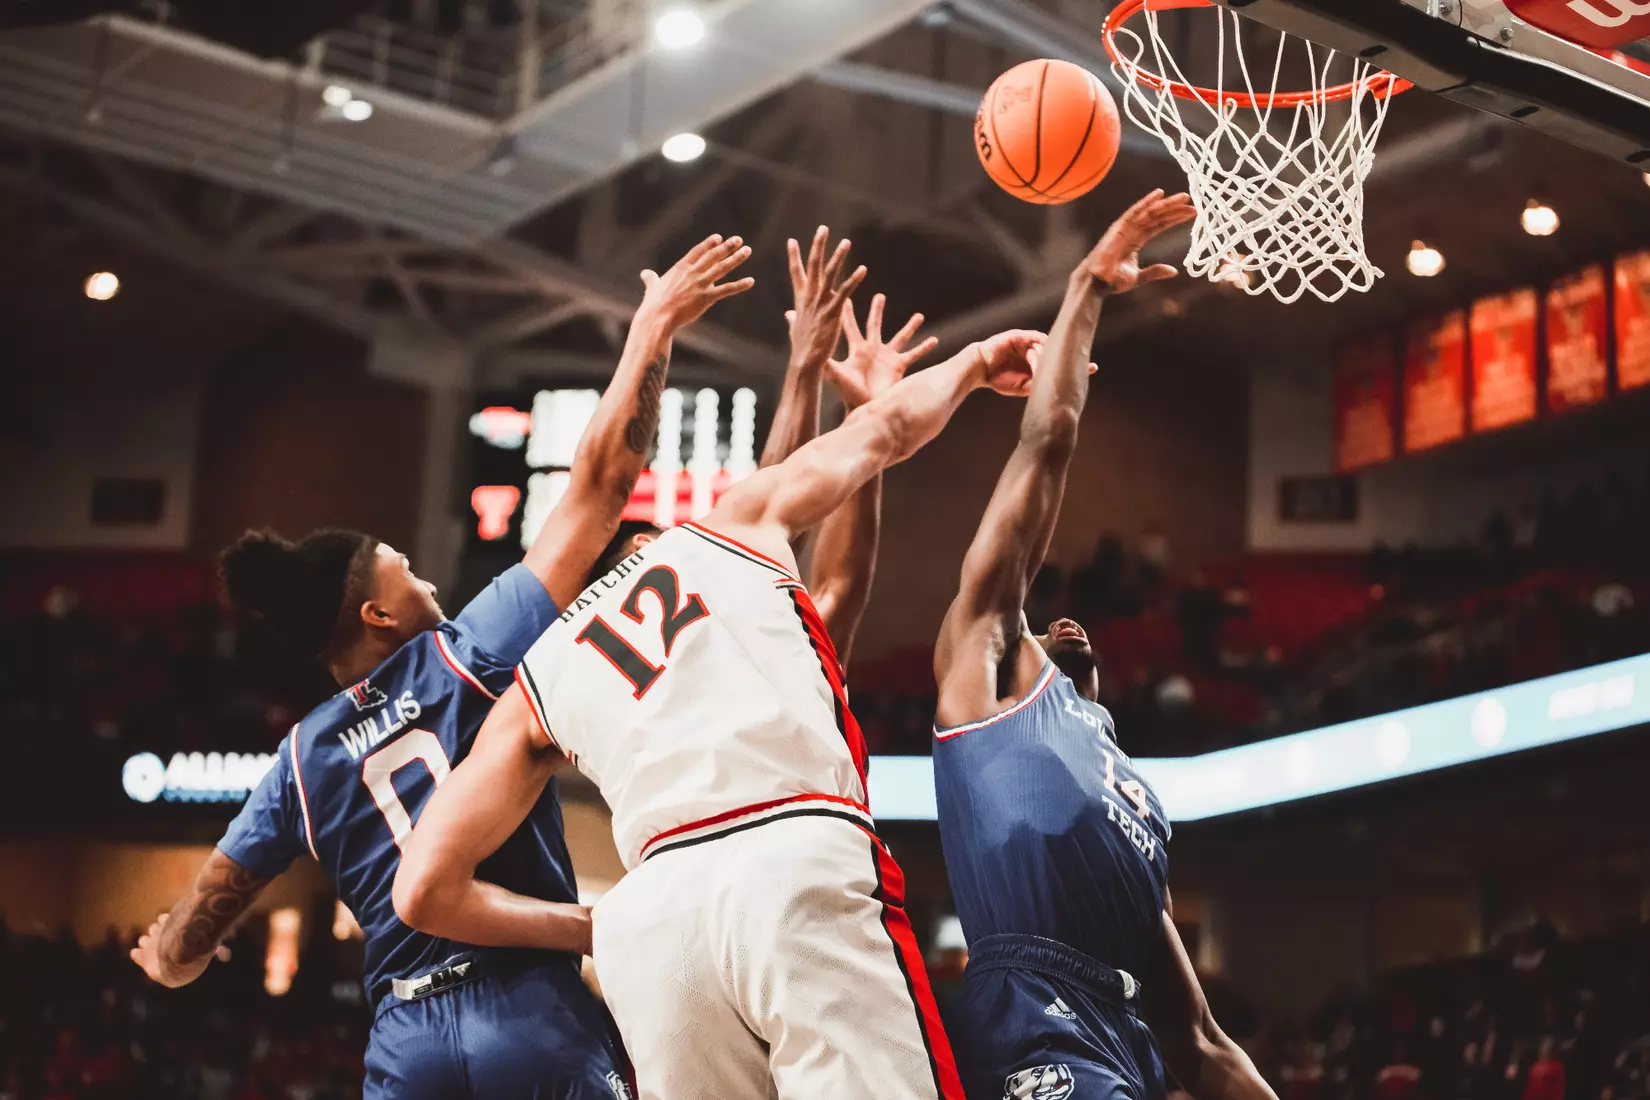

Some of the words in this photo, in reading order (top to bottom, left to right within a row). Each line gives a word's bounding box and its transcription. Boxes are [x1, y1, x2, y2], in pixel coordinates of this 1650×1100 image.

[575, 564, 710, 701] 12
[338, 690, 421, 760] WILLIS
[1102, 748, 1149, 820] 14
[1102, 794, 1156, 862] TECH
